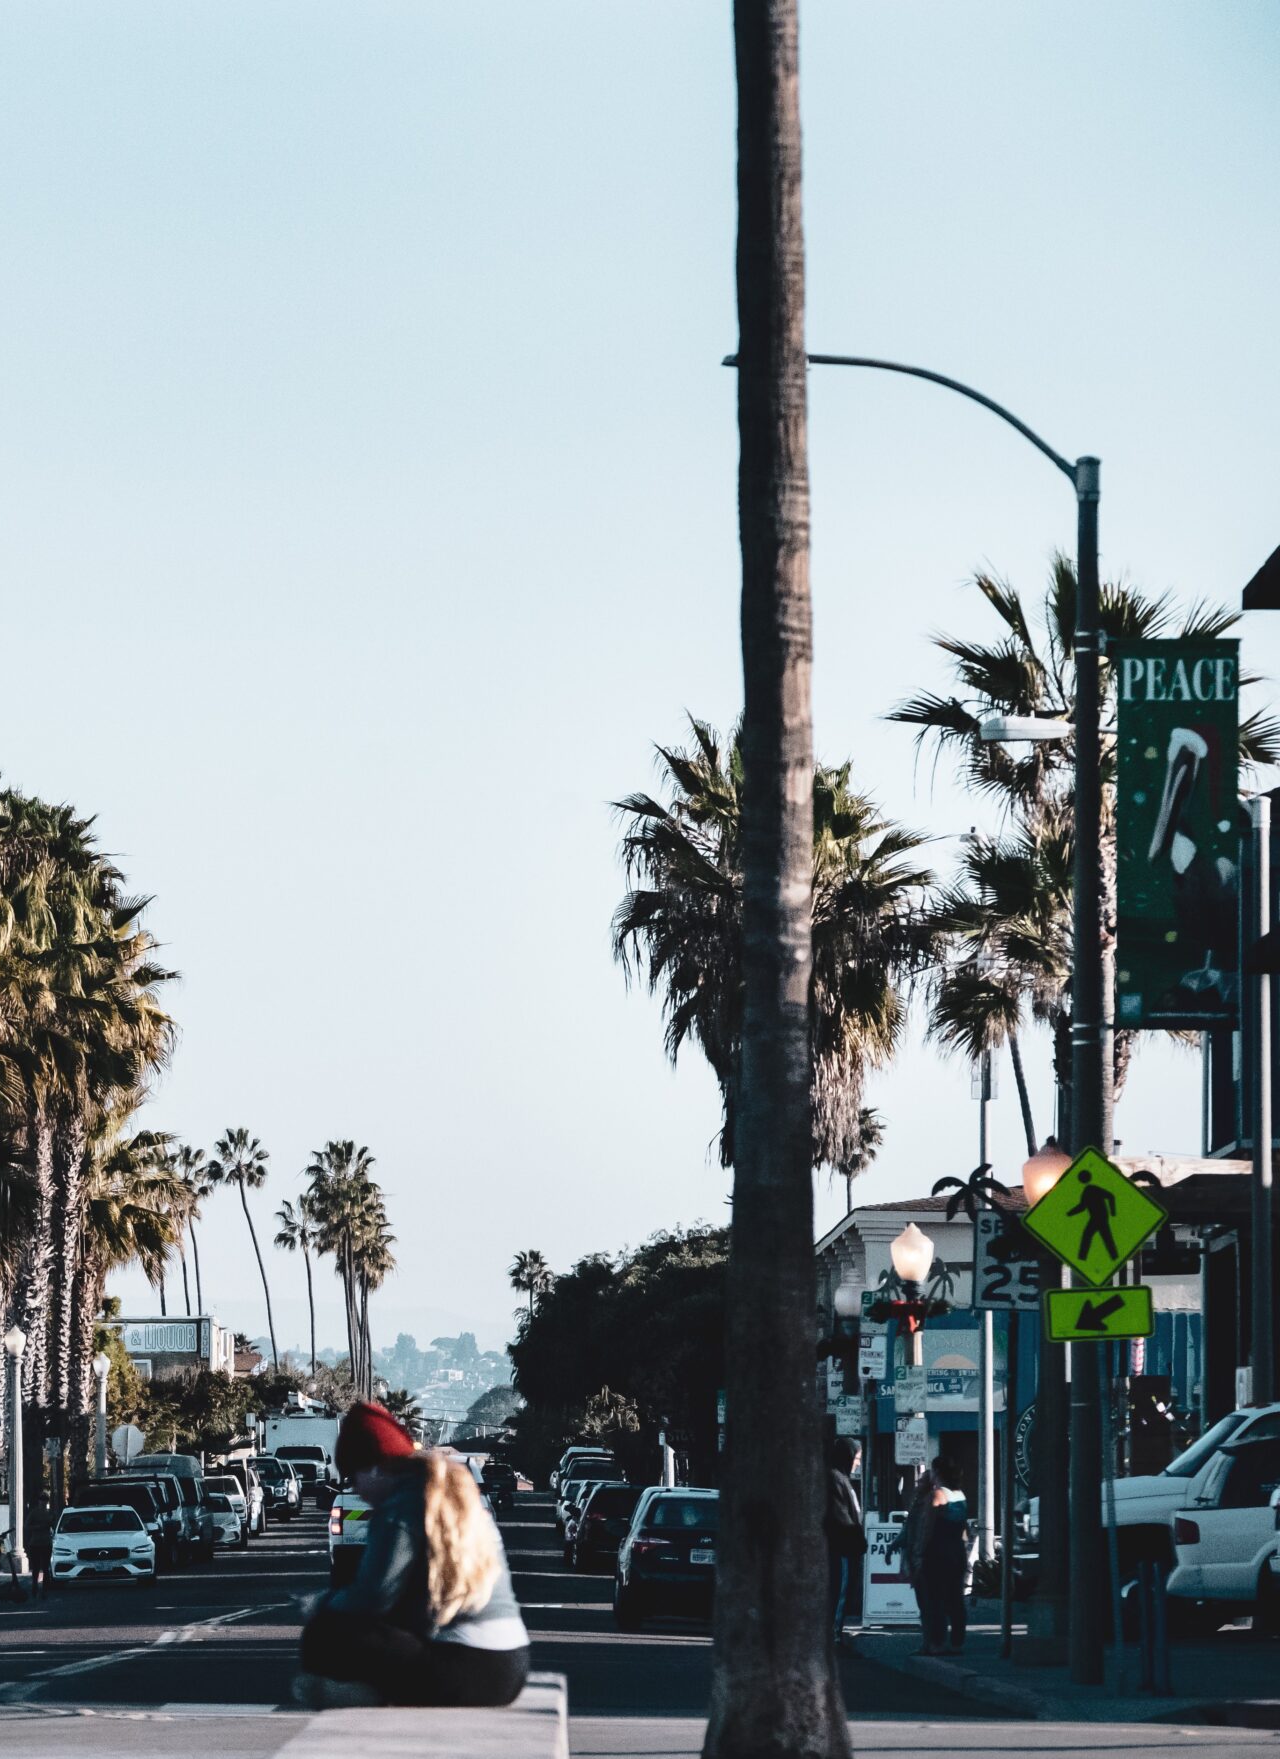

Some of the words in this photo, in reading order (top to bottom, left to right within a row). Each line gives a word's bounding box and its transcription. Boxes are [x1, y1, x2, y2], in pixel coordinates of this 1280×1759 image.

[1121, 657, 1236, 701] PEACE
[981, 1264, 1040, 1302] 25
[131, 1329, 141, 1345] &
[145, 1325, 195, 1350] LIQUOR
[861, 1337, 871, 1347] NO
[861, 1351, 884, 1359] PARKING
[898, 1367, 905, 1378] 2
[838, 1396, 845, 1407] 2
